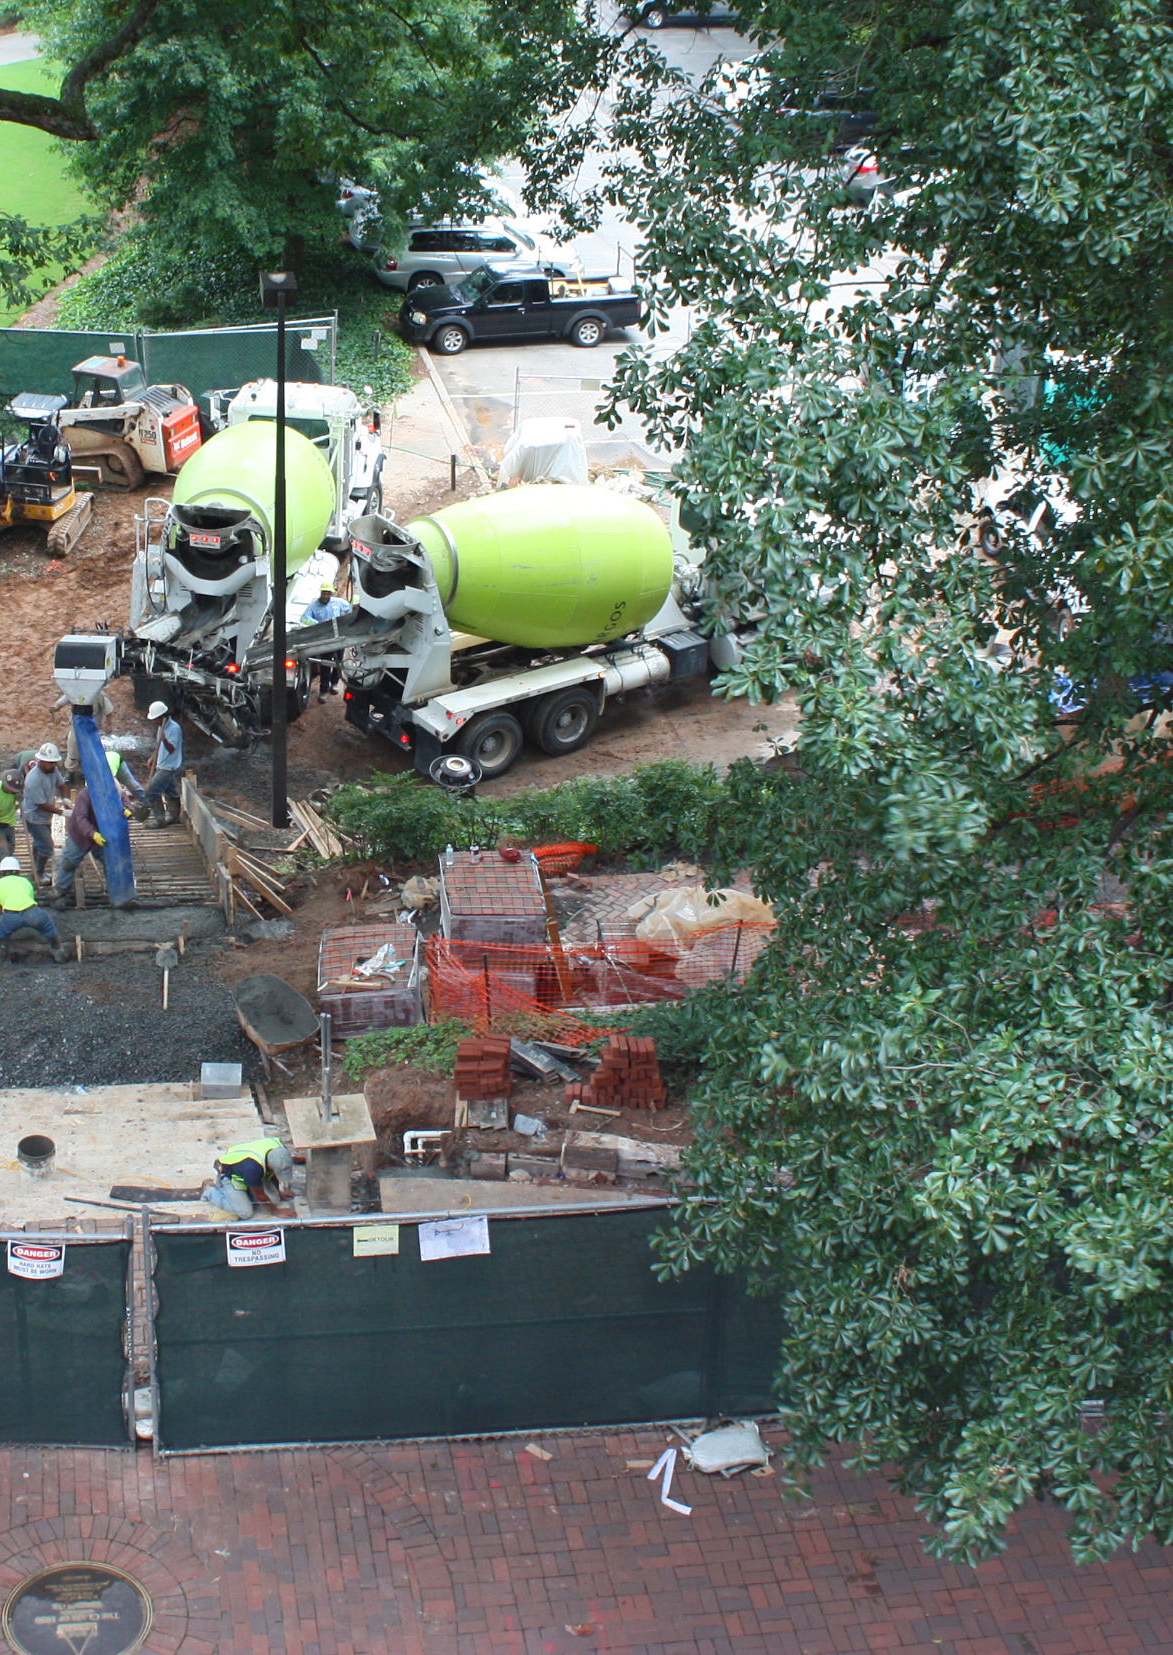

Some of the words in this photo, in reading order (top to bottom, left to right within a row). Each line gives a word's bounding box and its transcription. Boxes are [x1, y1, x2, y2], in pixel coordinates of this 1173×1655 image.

[181, 431, 197, 448] Bobcat
[236, 1237, 275, 1246] DANGER
[17, 1248, 56, 1257] DANGER
[234, 1253, 279, 1262] TRESPASSING
[14, 1264, 28, 1273] MUST
